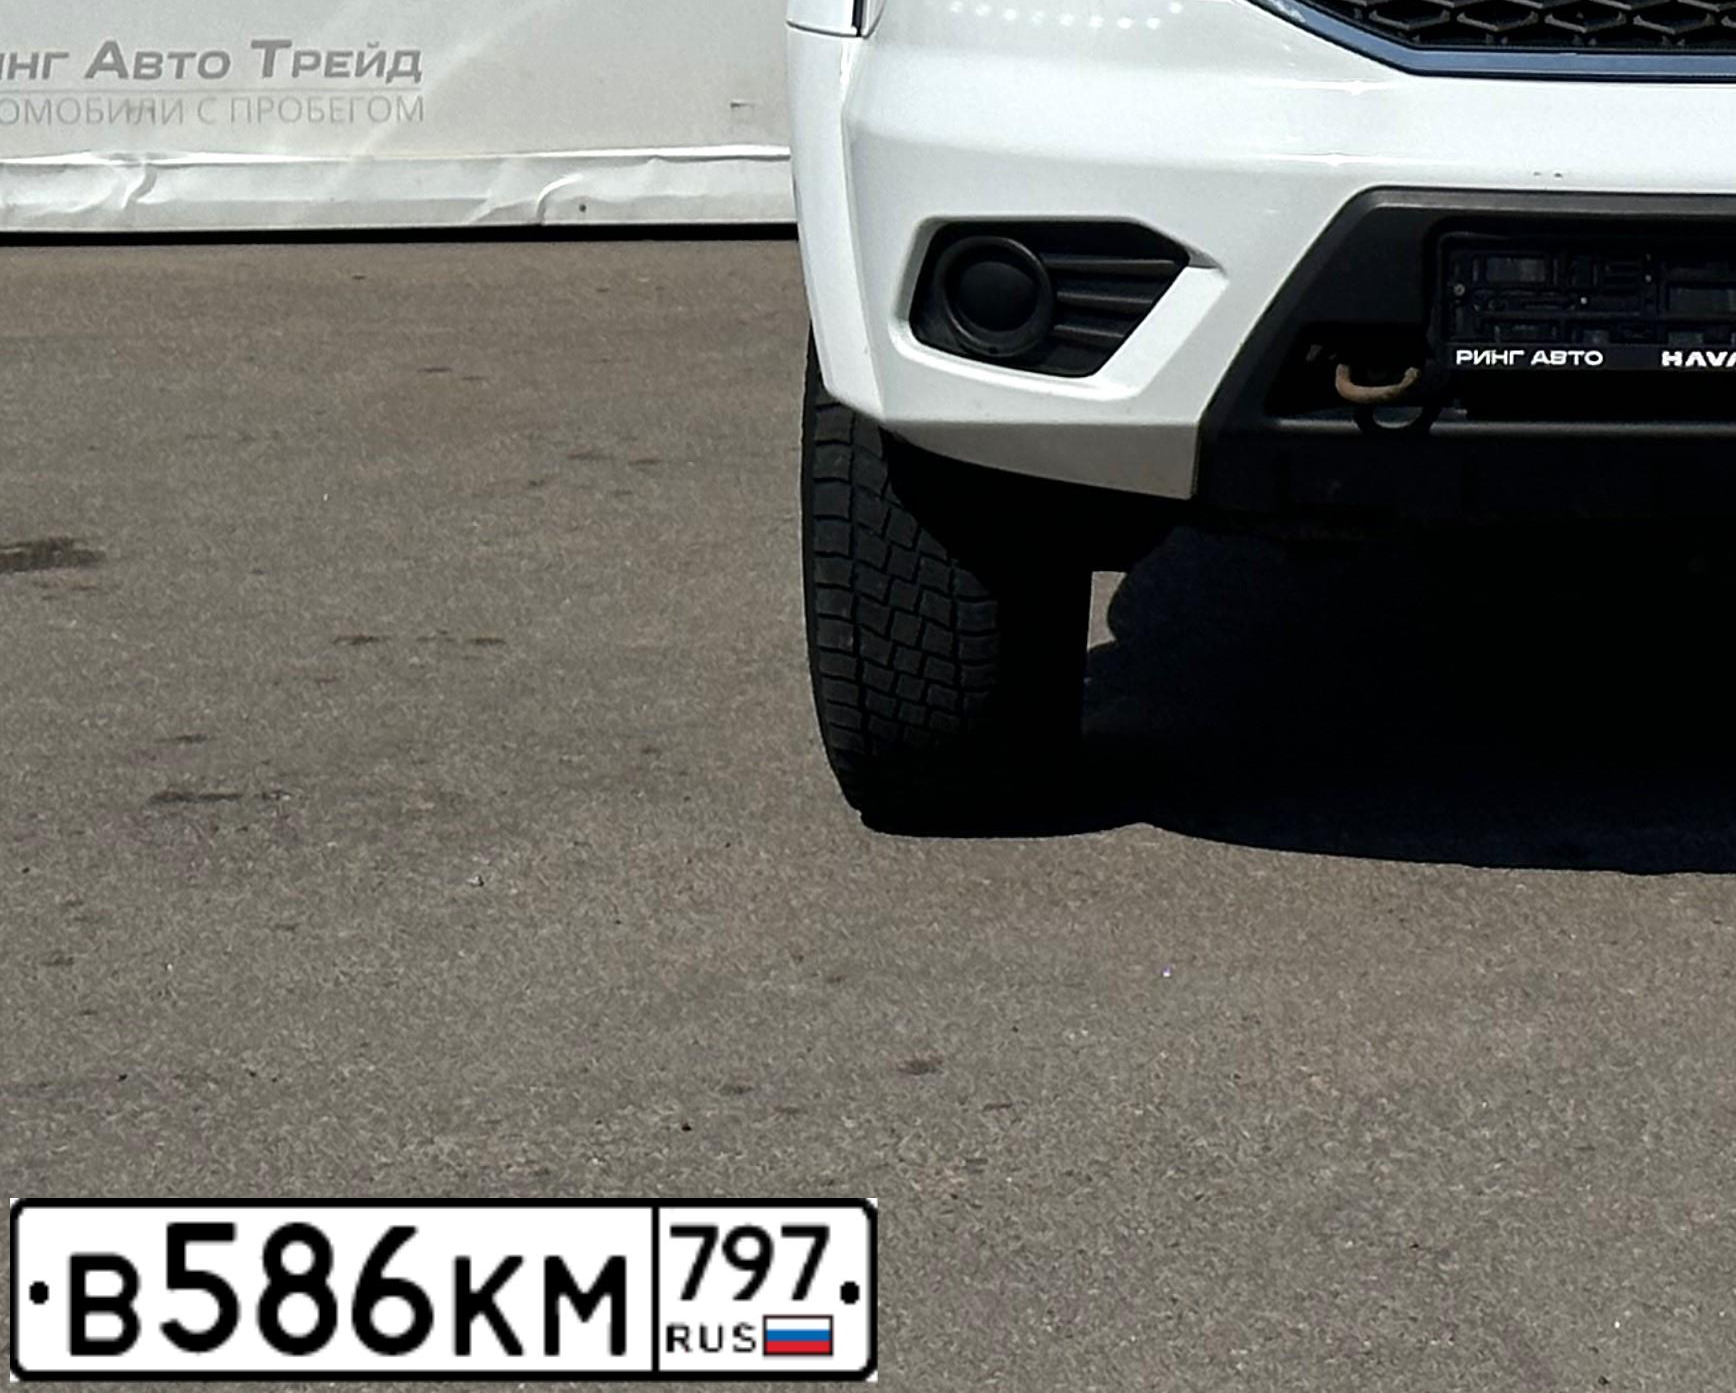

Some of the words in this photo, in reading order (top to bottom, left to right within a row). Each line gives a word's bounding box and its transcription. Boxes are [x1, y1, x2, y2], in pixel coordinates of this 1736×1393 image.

[85, 40, 230, 80] Авто
[251, 39, 422, 84] Трейд
[196, 96, 217, 124] С
[230, 95, 423, 122] ПРОБЕГОМ
[1455, 349, 1524, 366] РИНГ
[1530, 349, 1604, 366] АВТО
